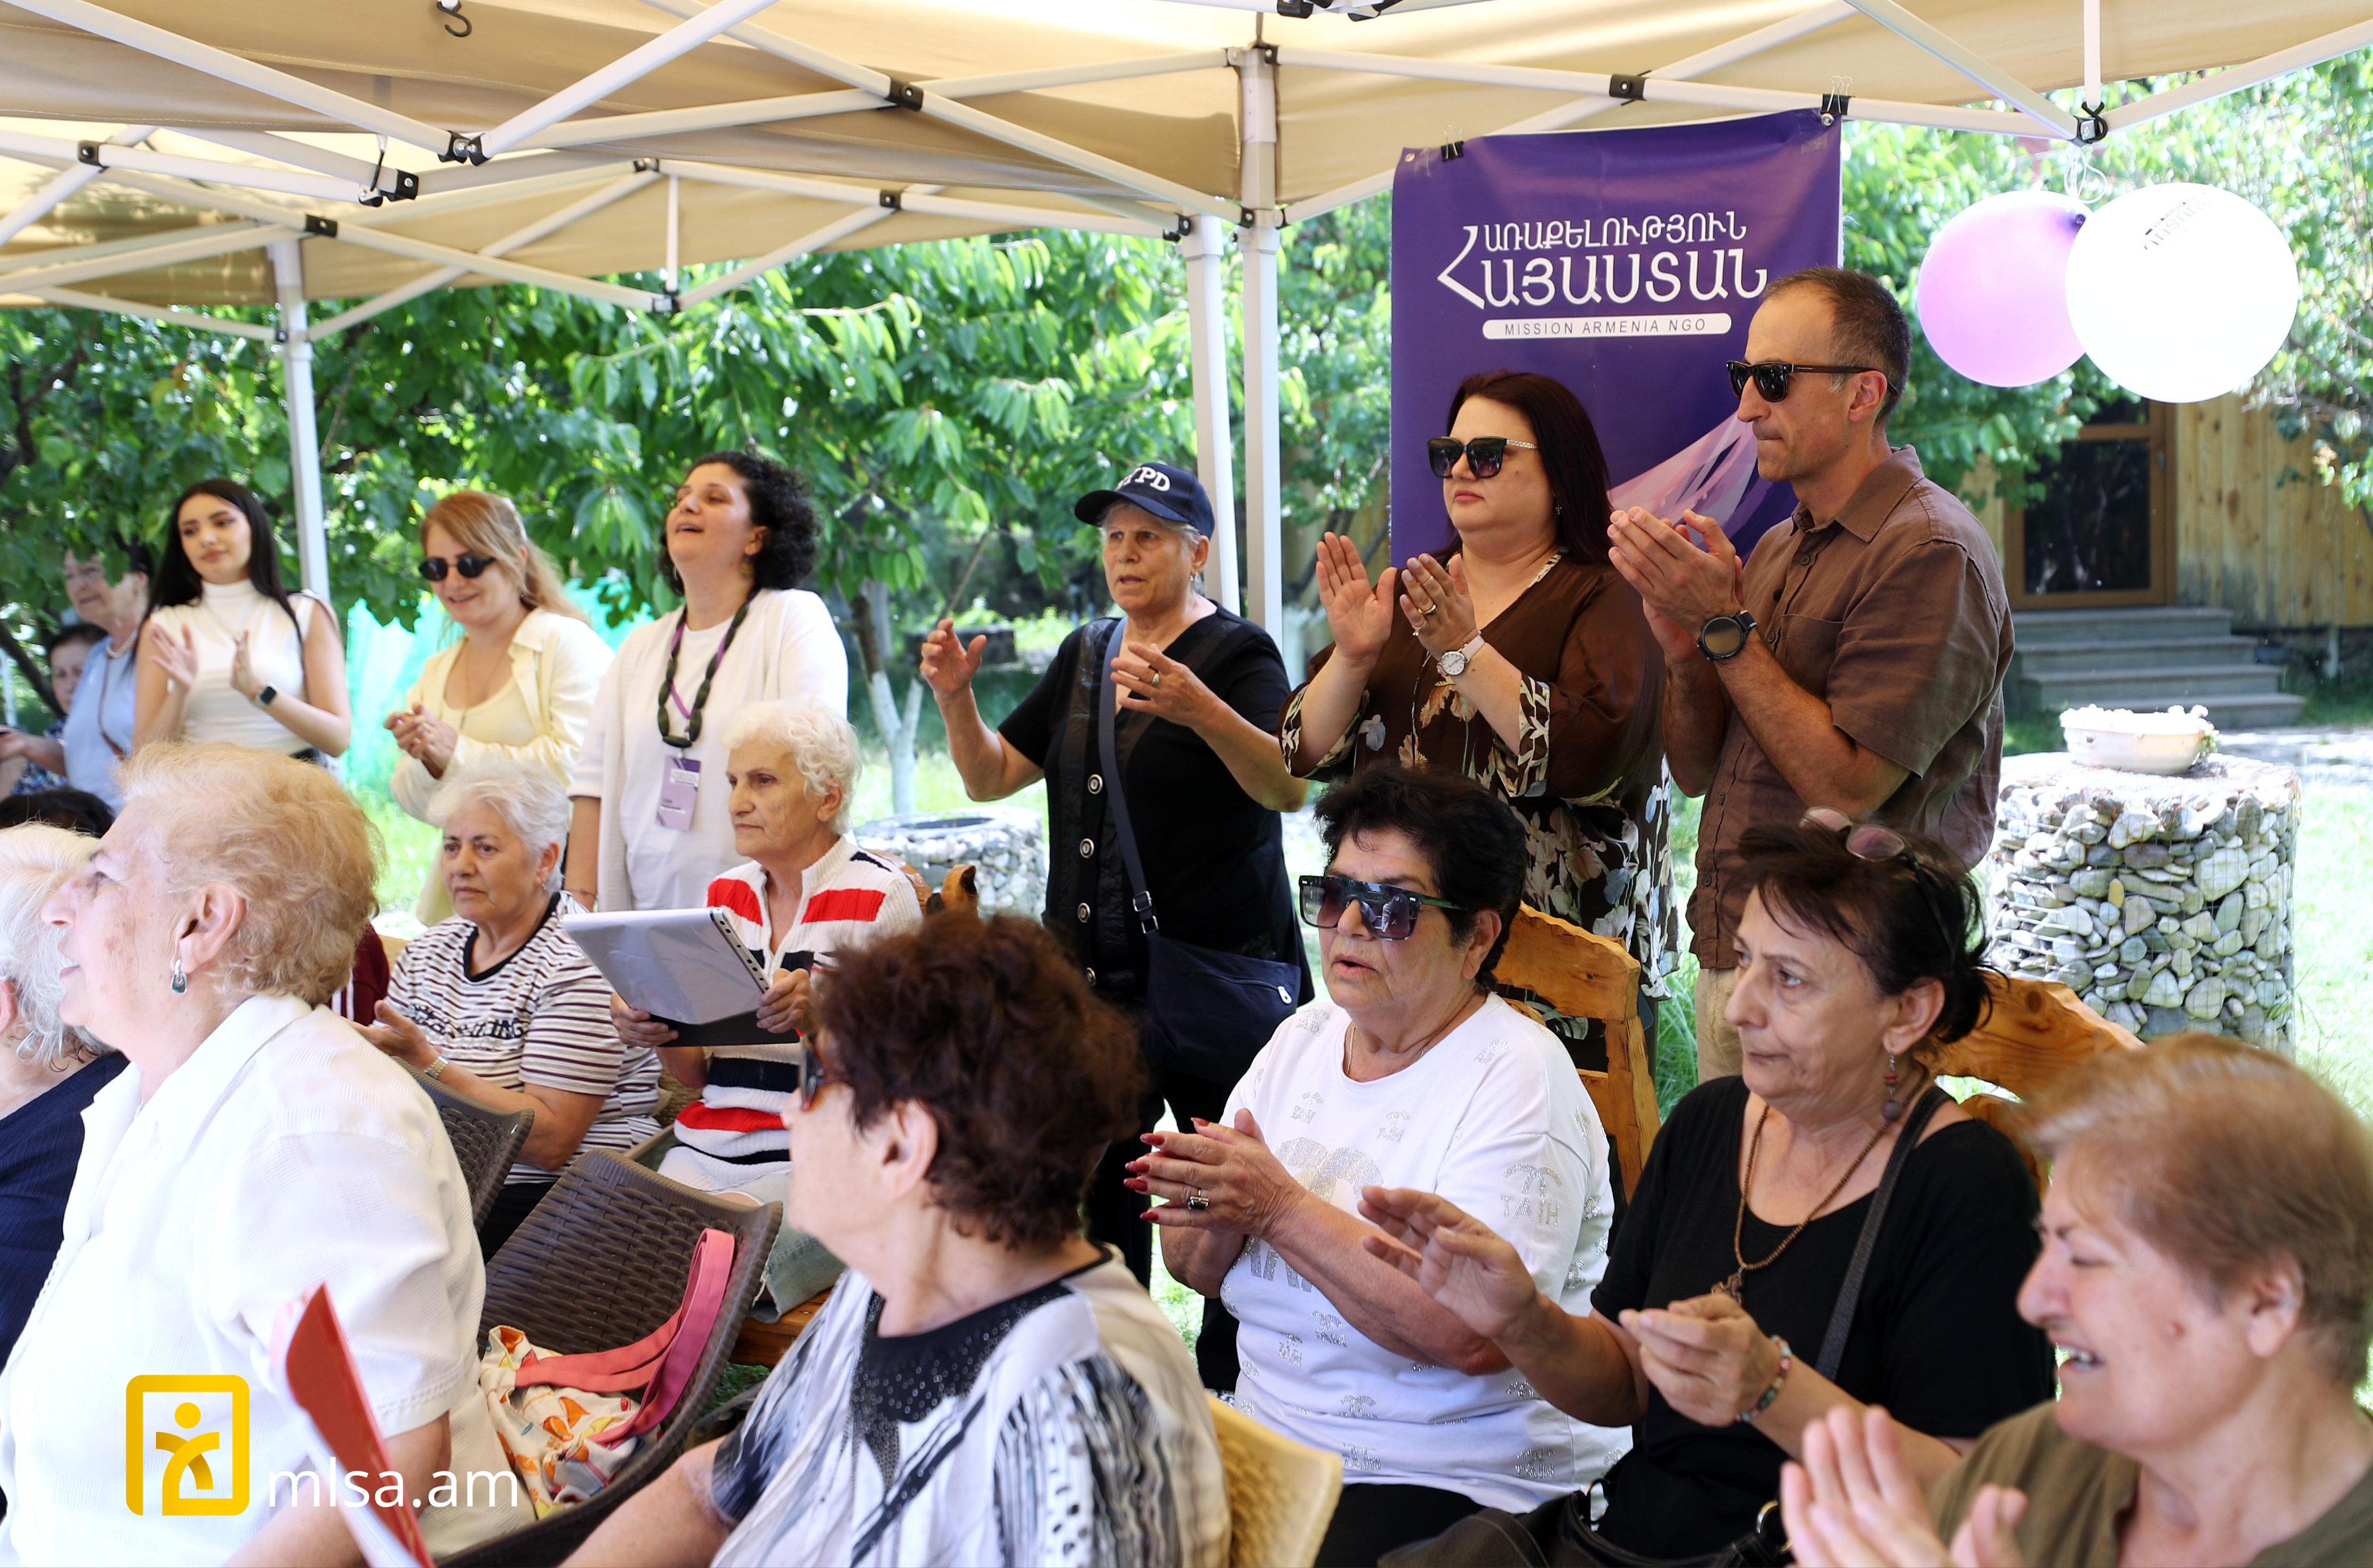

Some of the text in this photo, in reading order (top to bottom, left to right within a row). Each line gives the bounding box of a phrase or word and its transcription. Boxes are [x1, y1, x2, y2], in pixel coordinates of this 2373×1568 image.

[1437, 225, 1768, 310] ՀԱՅԱՍՏԱՆ
[1505, 319, 1706, 336] MISSION ARMENIA NGO
